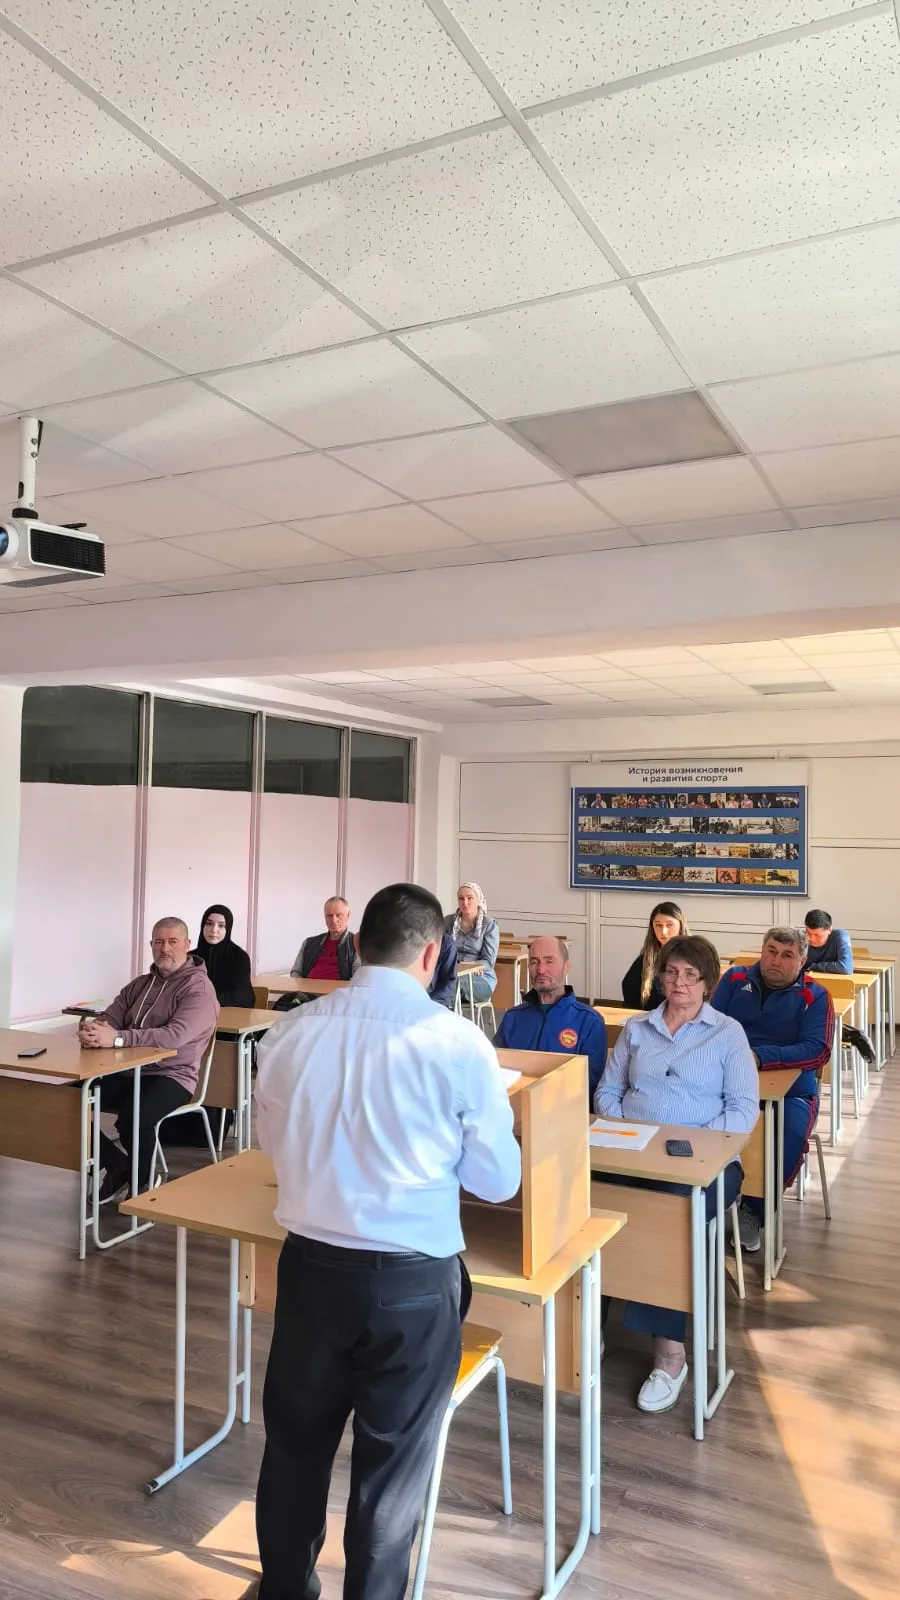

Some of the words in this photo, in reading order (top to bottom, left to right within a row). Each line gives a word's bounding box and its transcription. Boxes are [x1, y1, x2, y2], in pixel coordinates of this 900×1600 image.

[628, 767, 667, 775] История
[669, 766, 743, 775] возникновения
[650, 776, 693, 784] развития
[695, 775, 728, 784] спорта
